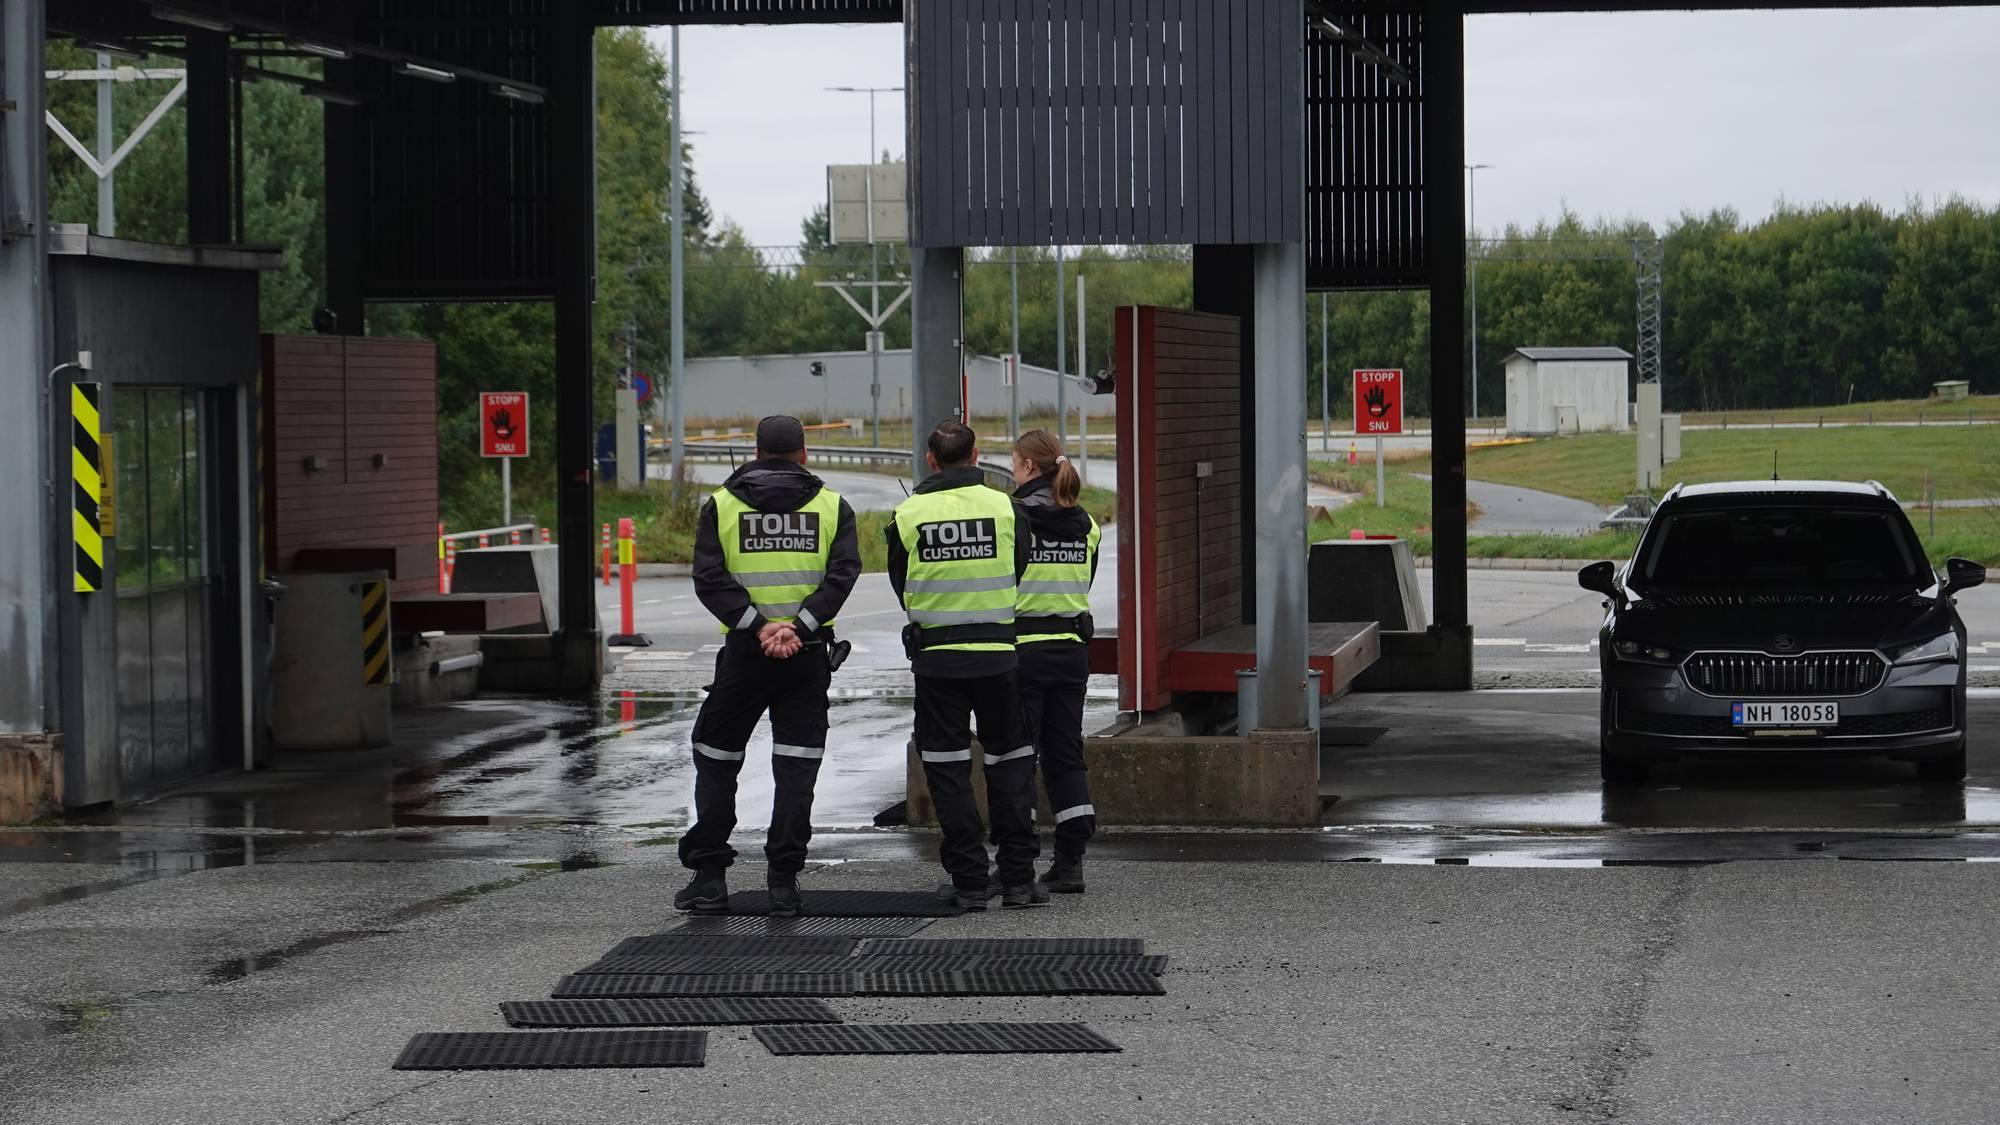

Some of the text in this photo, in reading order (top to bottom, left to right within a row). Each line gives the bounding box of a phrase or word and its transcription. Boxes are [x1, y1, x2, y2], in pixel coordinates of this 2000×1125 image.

[1361, 372, 1394, 382] STOPP
[1368, 421, 1389, 430] SNU
[743, 513, 815, 535] TOLL
[921, 520, 992, 545] TOLL
[744, 536, 815, 550] CUSTOMS
[922, 544, 993, 560] CUSTOMS
[1747, 705, 1835, 721] NH 18058
